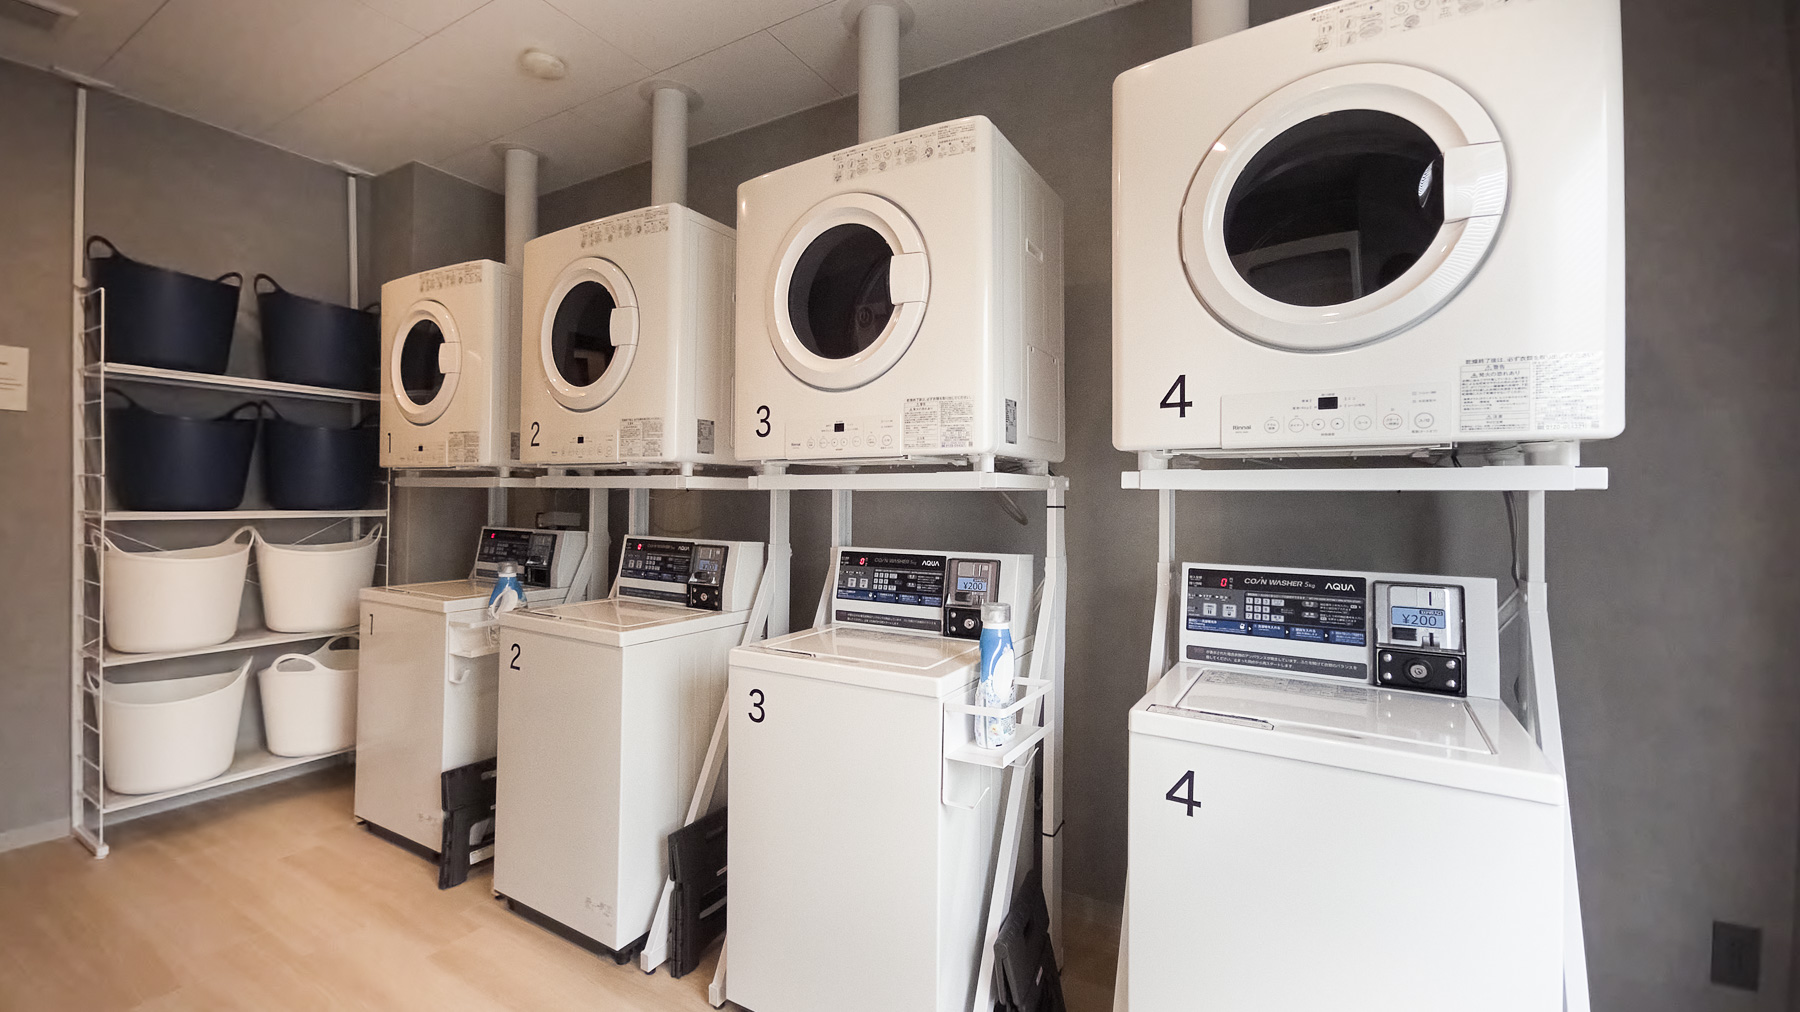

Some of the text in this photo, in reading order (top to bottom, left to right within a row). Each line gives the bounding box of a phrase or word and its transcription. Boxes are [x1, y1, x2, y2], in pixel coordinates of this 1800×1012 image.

[1160, 375, 1193, 418] 4
[756, 406, 770, 438] 3
[388, 433, 392, 452] 1
[530, 422, 540, 446] 2
[963, 581, 982, 590] ¥200
[1220, 578, 1228, 587] 0
[1244, 576, 1267, 585] COIN
[1325, 582, 1356, 591] AQUA
[370, 614, 373, 636] 1
[1402, 614, 1437, 626] ¥200
[510, 644, 520, 670] 2
[748, 688, 766, 724] 3
[1166, 770, 1202, 818] 4
